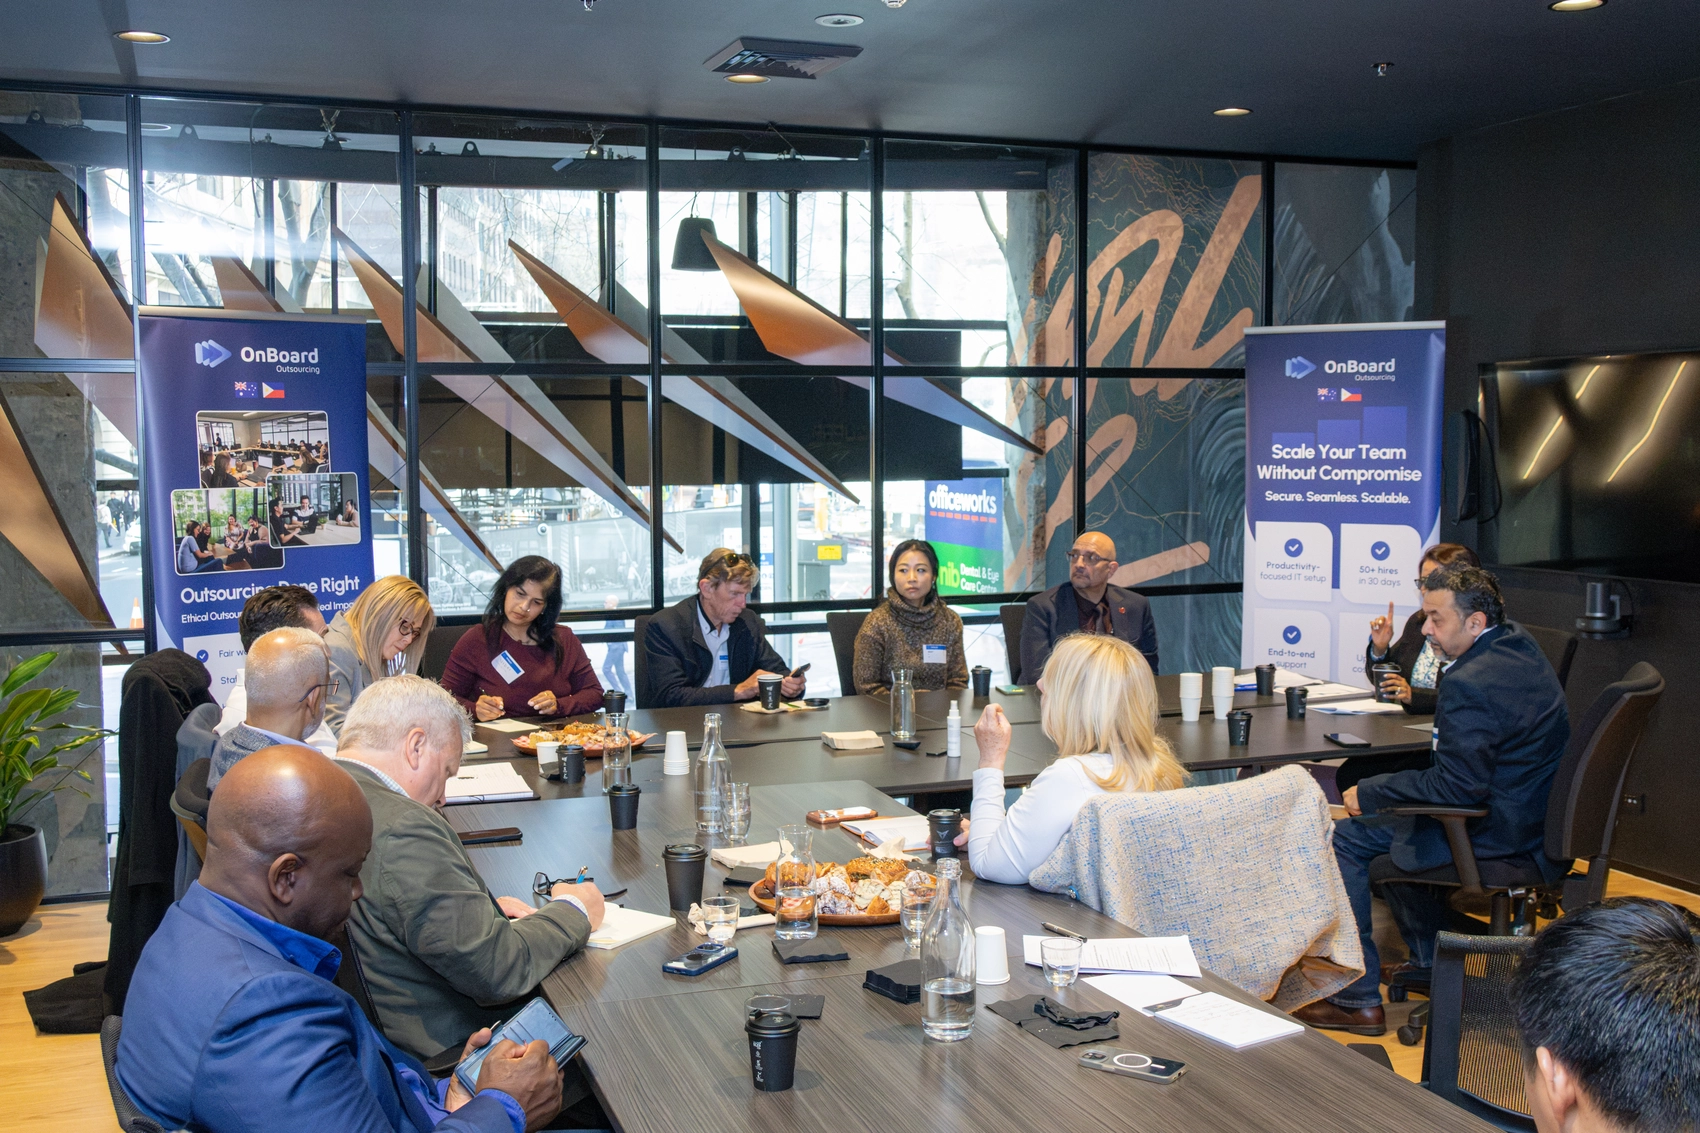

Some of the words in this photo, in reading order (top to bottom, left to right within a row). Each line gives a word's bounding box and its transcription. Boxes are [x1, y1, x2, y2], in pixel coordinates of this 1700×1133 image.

[240, 346, 319, 364] OnBoard
[276, 365, 321, 375] Outsourcing
[1324, 358, 1396, 374] OnBoard
[1354, 374, 1396, 382] Outsourcing
[1271, 443, 1316, 460] Scale
[1318, 444, 1356, 460] Your
[1358, 444, 1407, 460] Team
[1257, 464, 1317, 480] Without
[1319, 465, 1423, 486] Compromise
[928, 483, 998, 515] officeworks
[1264, 490, 1305, 502] Secure.
[1306, 491, 1359, 503] Seamless.
[1360, 492, 1411, 505] Scalable.
[960, 562, 981, 578] Dental
[981, 566, 987, 579] &
[987, 567, 1000, 584] Eye
[1266, 561, 1321, 573] Productivity-
[1359, 565, 1376, 575] 50+
[1378, 565, 1399, 575] hires
[939, 561, 960, 589] nib
[1260, 572, 1293, 581] focused
[1293, 573, 1302, 581] IT
[1303, 574, 1327, 585] setup
[960, 577, 976, 592] Care
[1358, 577, 1367, 585] in
[1368, 577, 1379, 586] 30
[1380, 577, 1401, 587] days
[180, 583, 274, 604] Outsourcin
[320, 575, 361, 596] Right
[333, 601, 354, 612] Impa
[181, 612, 209, 624] Ethical
[209, 611, 242, 620] Outsour
[218, 649, 235, 658] Fair
[1268, 648, 1316, 659] End-to-end
[1275, 660, 1307, 670] support
